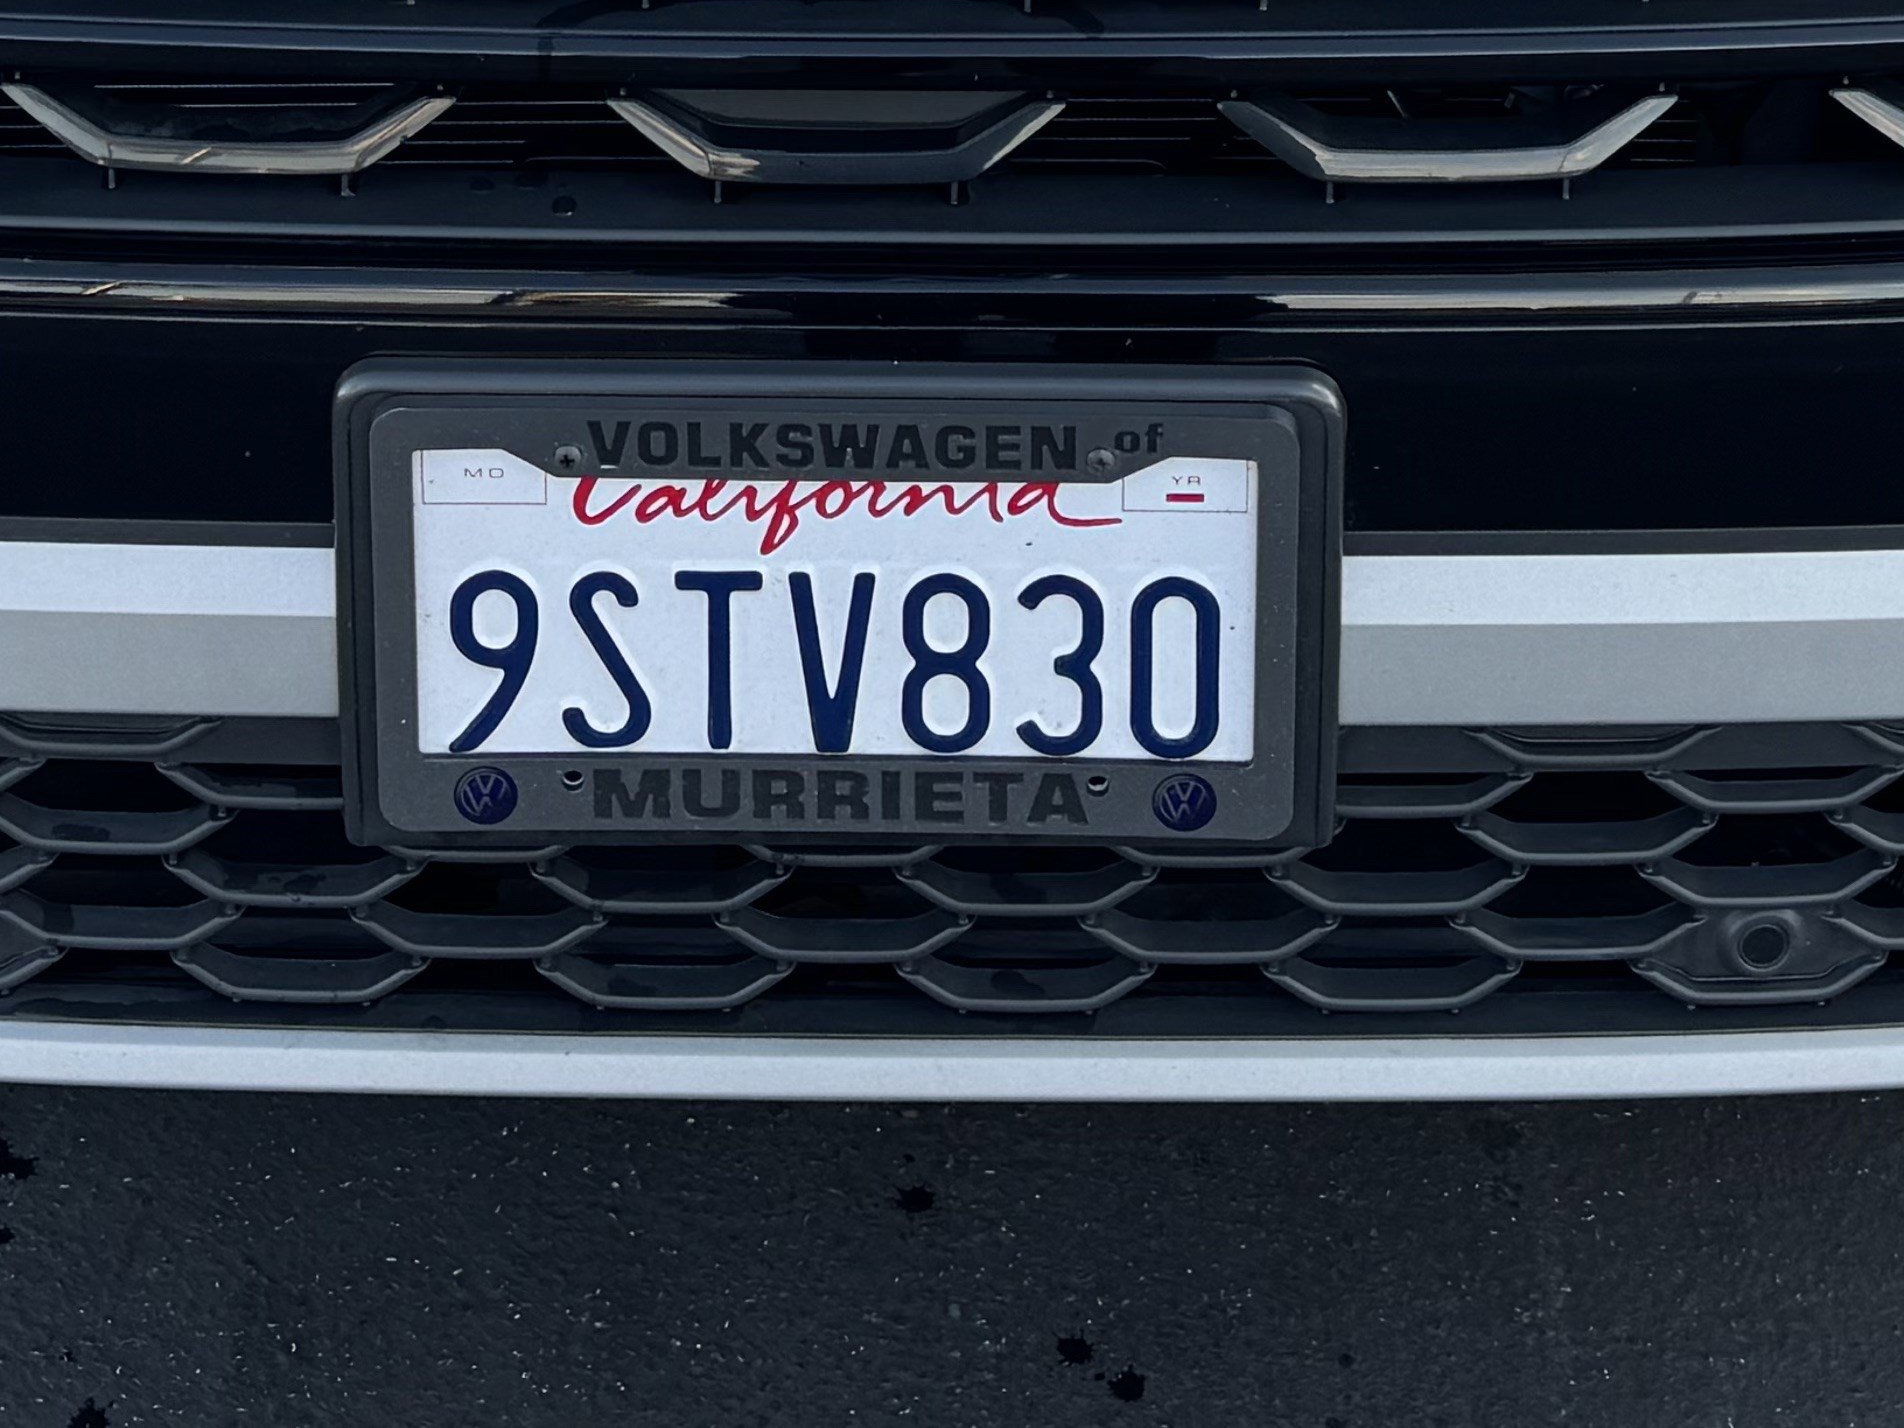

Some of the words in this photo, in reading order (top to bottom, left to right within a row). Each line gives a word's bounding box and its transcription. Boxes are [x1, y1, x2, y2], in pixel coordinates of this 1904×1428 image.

[586, 419, 1078, 470] VOLKSWAGEN
[1114, 423, 1164, 453] of
[464, 467, 504, 479] MO
[1171, 475, 1201, 486] YR
[448, 570, 1221, 757] 9STV830
[592, 768, 1089, 825] MURRIETA
